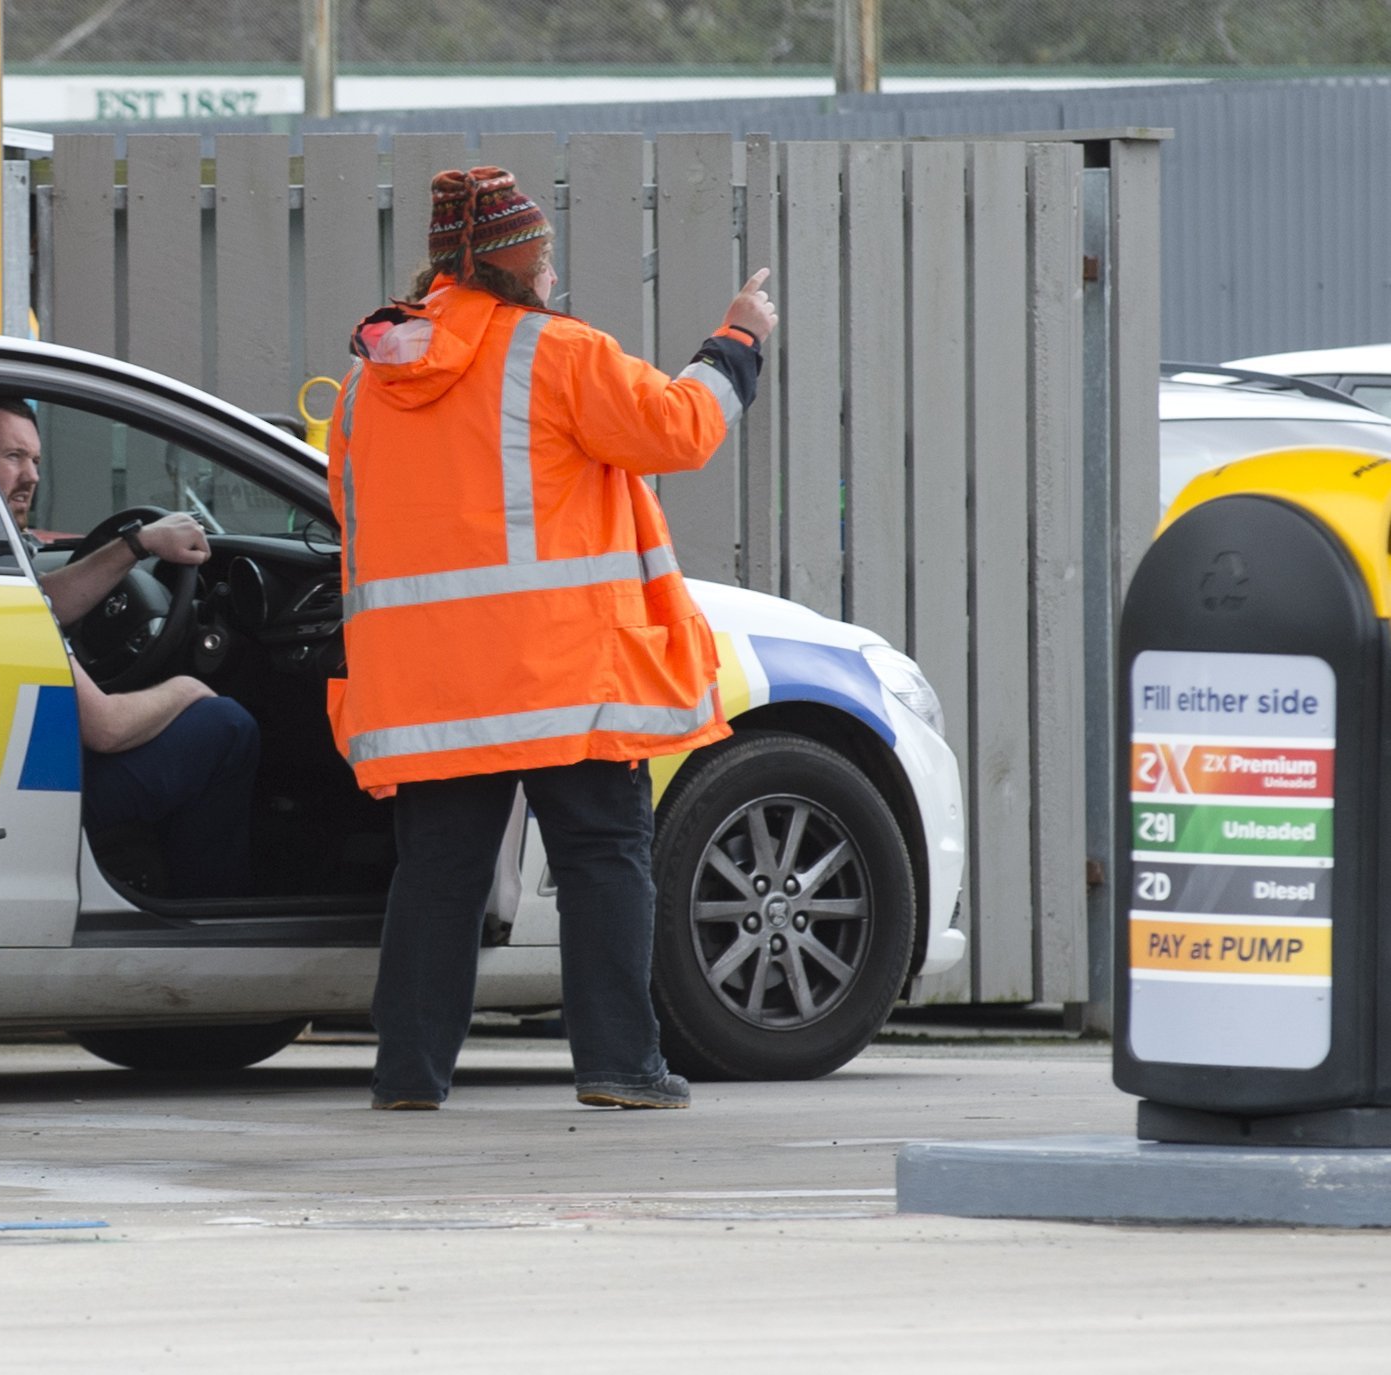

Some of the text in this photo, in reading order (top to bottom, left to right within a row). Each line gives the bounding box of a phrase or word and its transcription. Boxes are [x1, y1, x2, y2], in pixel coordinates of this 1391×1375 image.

[95, 89, 260, 121] EST 1887
[1143, 684, 1319, 715] Fill either side
[1201, 754, 1317, 776] ZX Premium
[1263, 777, 1317, 789] Unleaded
[1223, 820, 1317, 842] Unleaded
[1253, 880, 1316, 901] Diesel
[1148, 932, 1304, 963] PAY at PUMP
